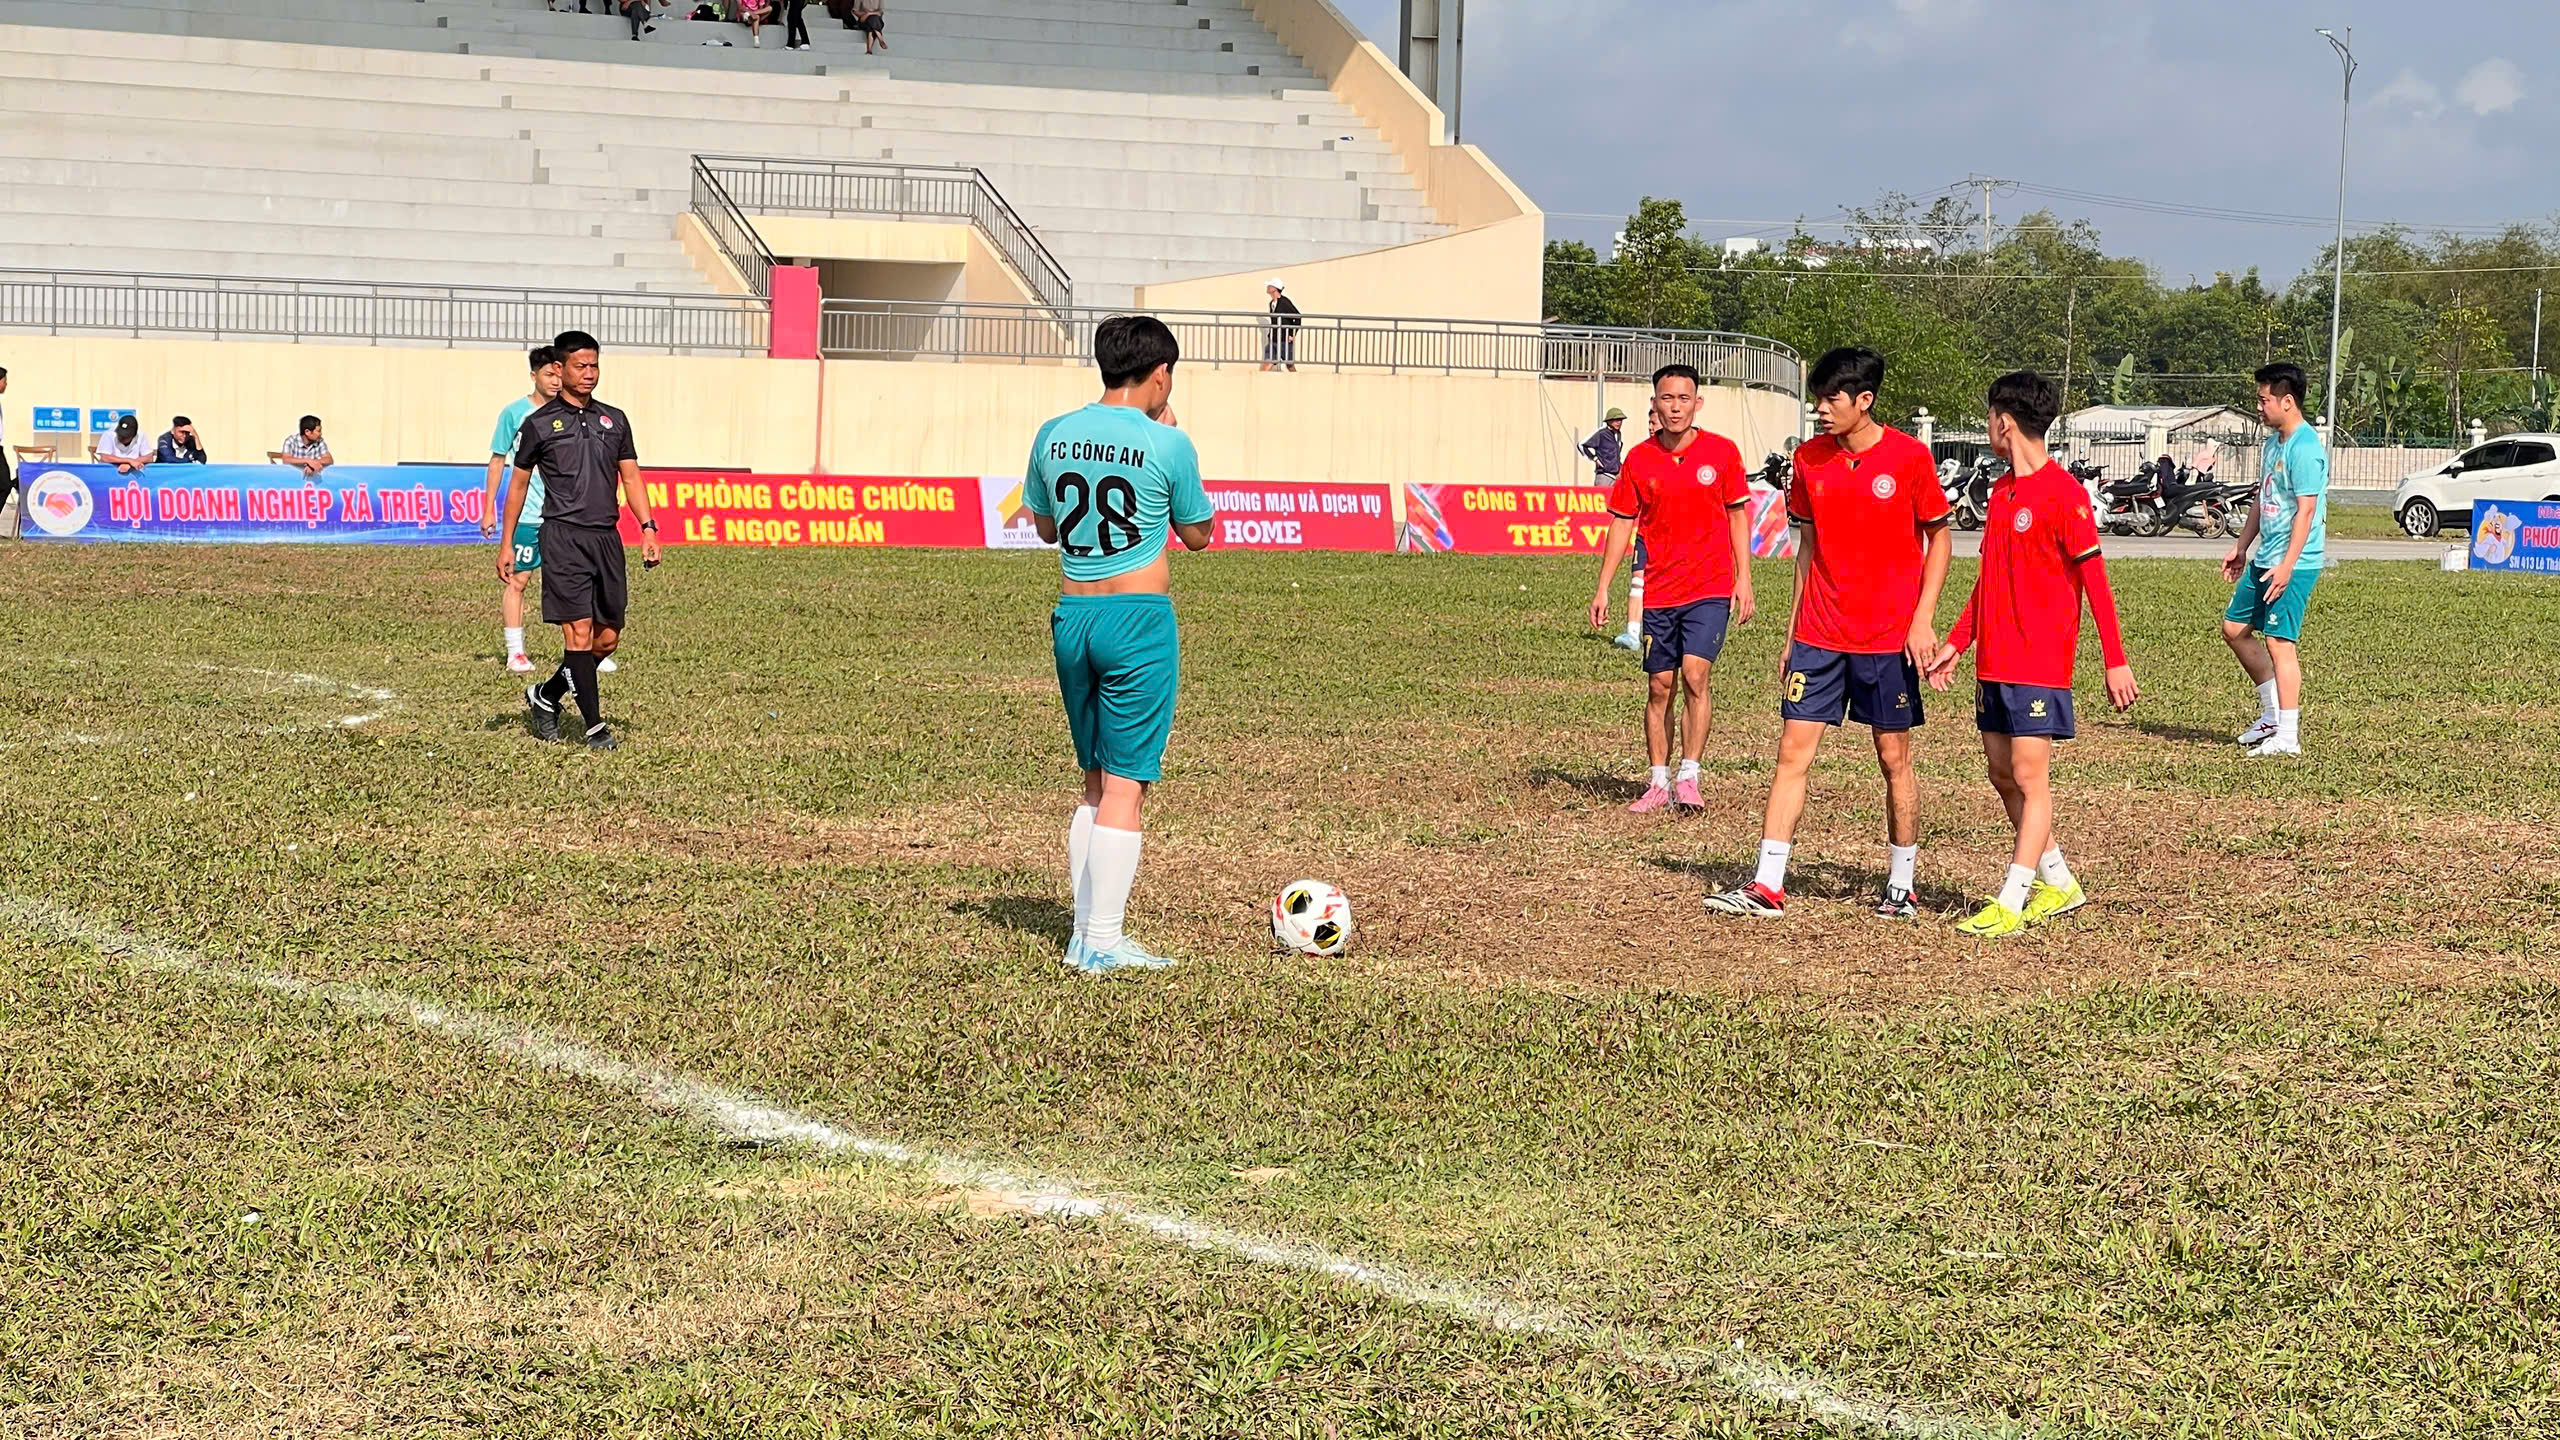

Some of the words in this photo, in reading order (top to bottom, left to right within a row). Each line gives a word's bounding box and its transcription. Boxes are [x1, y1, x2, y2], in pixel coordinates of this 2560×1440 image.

[1051, 441, 1066, 460] FC
[1072, 440, 1115, 463] CÔNG
[1119, 447, 1144, 468] AN
[109, 480, 152, 528] HỘI
[158, 487, 241, 521] DOANH
[247, 481, 333, 528] NGHIỆP
[340, 483, 374, 522] XÃ
[378, 482, 443, 529] TRIỆU
[675, 478, 773, 510] PHÒNG
[779, 479, 856, 511] CÔNG
[862, 481, 955, 512] CHỨNG
[1204, 489, 1261, 512] HƯƠNG
[1265, 493, 1296, 516] MẠI
[1298, 489, 1319, 512] VÀ
[1323, 494, 1358, 517] DỊCH
[1361, 495, 1382, 518] VỤ
[1463, 487, 1517, 511] CÔNG
[1524, 491, 1546, 512] TY
[1554, 489, 1608, 512] VÀNG
[1055, 471, 1142, 556] 28
[684, 514, 717, 542] LÊ
[725, 518, 802, 548] NGỌC
[809, 513, 885, 544] HUẤN
[1223, 520, 1303, 544] HOME
[1508, 516, 1573, 547] THẾ
[2522, 524, 2560, 549] PHƯƠ
[514, 544, 534, 563] 79
[2521, 556, 2535, 570] 413
